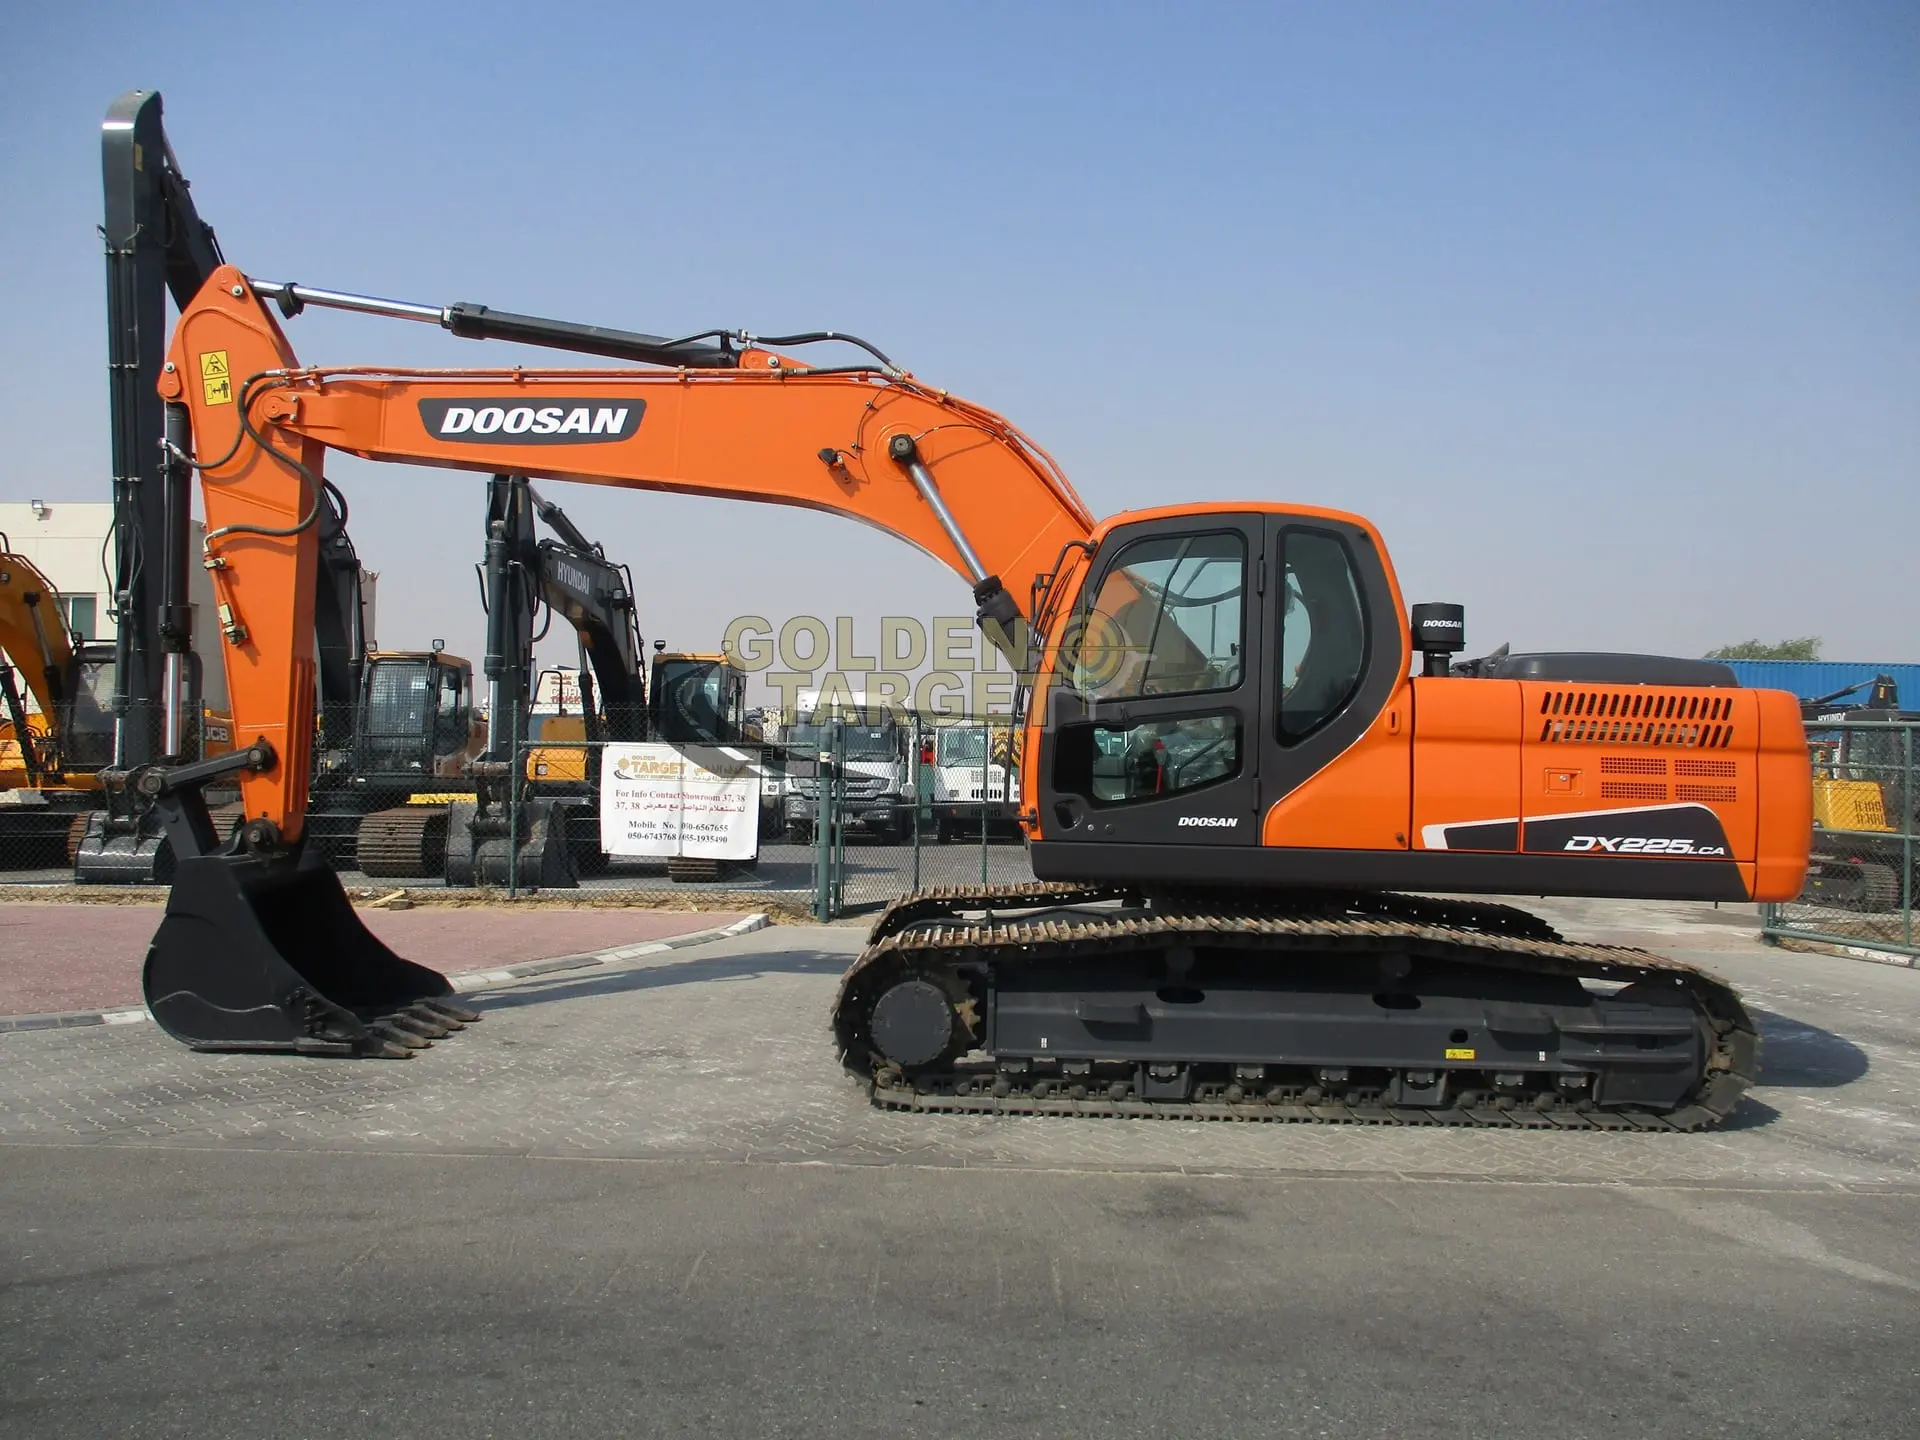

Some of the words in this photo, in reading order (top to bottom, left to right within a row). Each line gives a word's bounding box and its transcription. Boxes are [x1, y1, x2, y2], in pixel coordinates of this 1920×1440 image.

[440, 407, 629, 434] DOOSAN
[557, 560, 590, 595] HYUNDAI
[1422, 619, 1463, 628] DOOSAN
[1817, 711, 1846, 721] HYUND
[205, 726, 229, 742] JCB
[631, 761, 688, 774] TARGET
[615, 789, 629, 798] For
[631, 789, 648, 798] Info
[650, 789, 680, 800] Contact
[681, 791, 720, 802] Showroom
[722, 794, 735, 803] 37,
[737, 795, 746, 803] 38
[614, 801, 628, 811] 37,
[630, 802, 641, 810] 38
[628, 820, 657, 830] Mobile
[662, 821, 677, 830] No.
[1178, 816, 1239, 827] DOOSAN
[627, 831, 677, 841] 050-6743768
